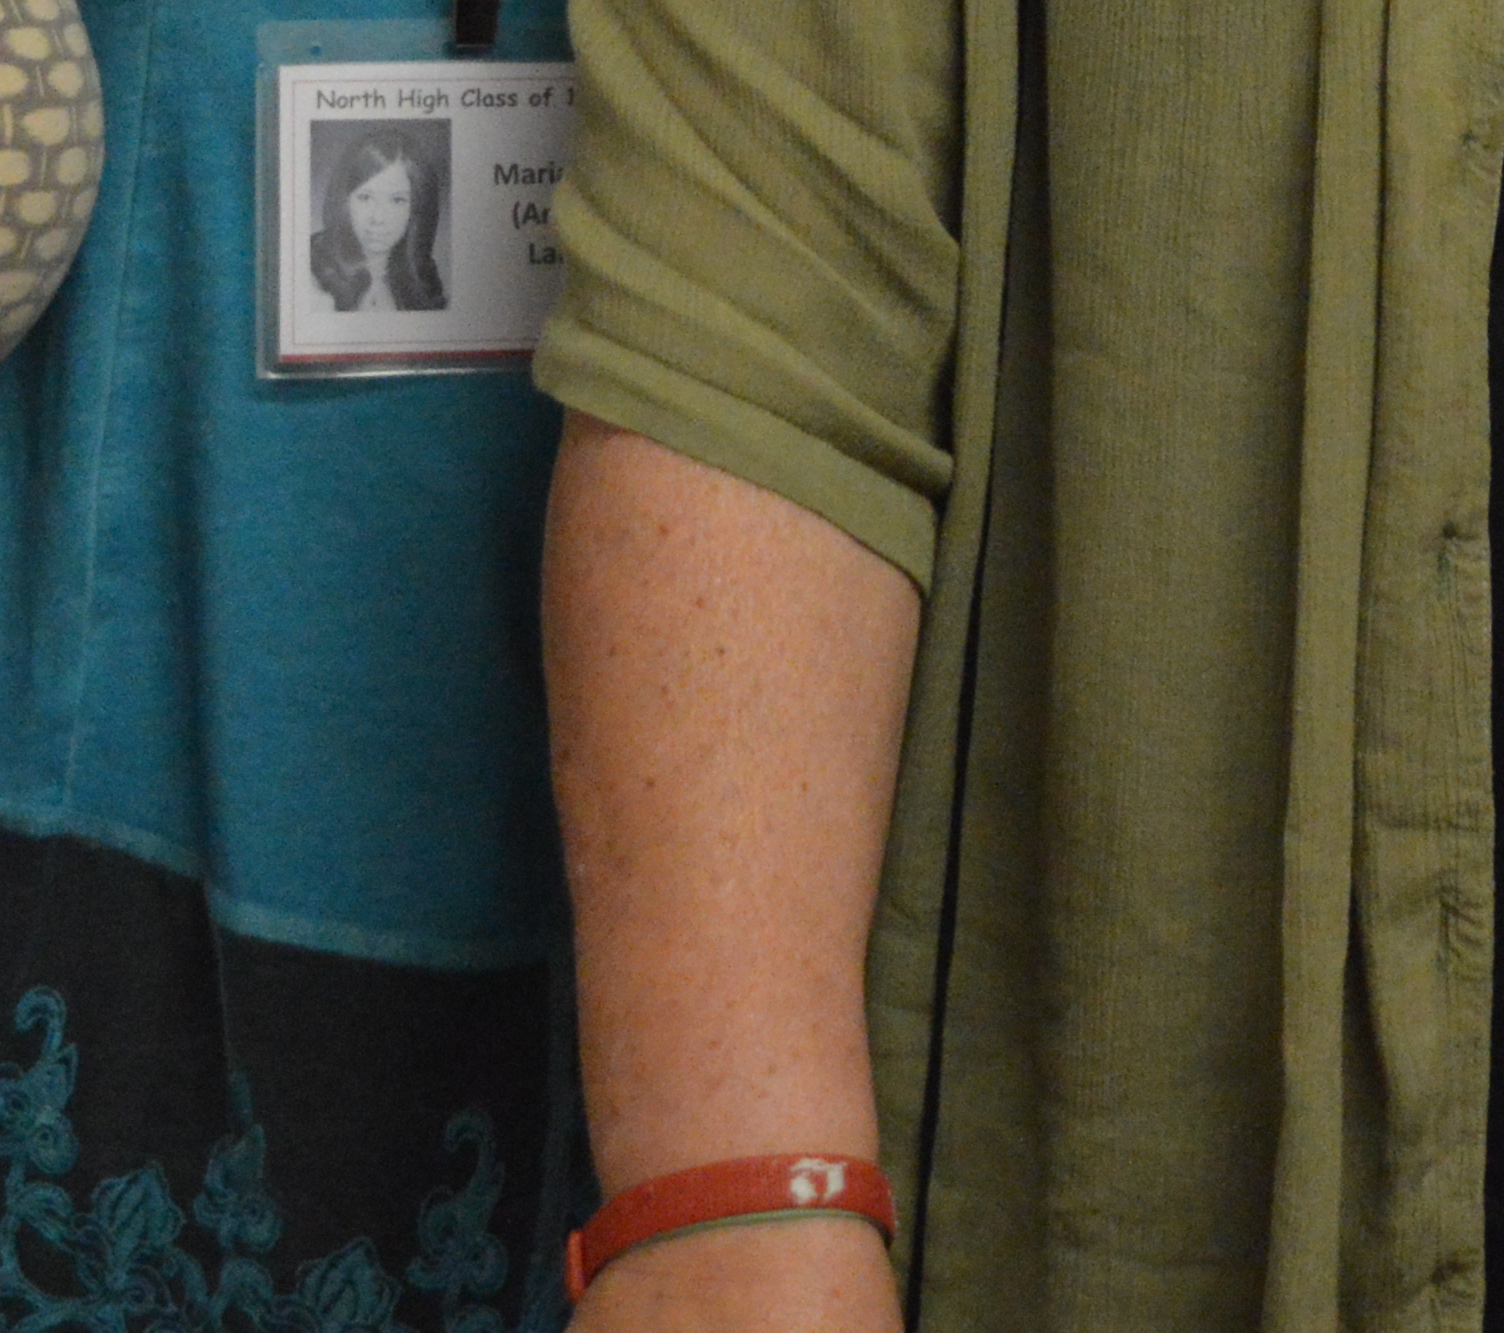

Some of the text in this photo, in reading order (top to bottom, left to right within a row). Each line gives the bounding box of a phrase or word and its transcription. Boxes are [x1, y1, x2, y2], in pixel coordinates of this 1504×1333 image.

[316, 88, 386, 110] North
[398, 88, 449, 114] High
[460, 87, 518, 109] Class
[528, 86, 554, 108] of
